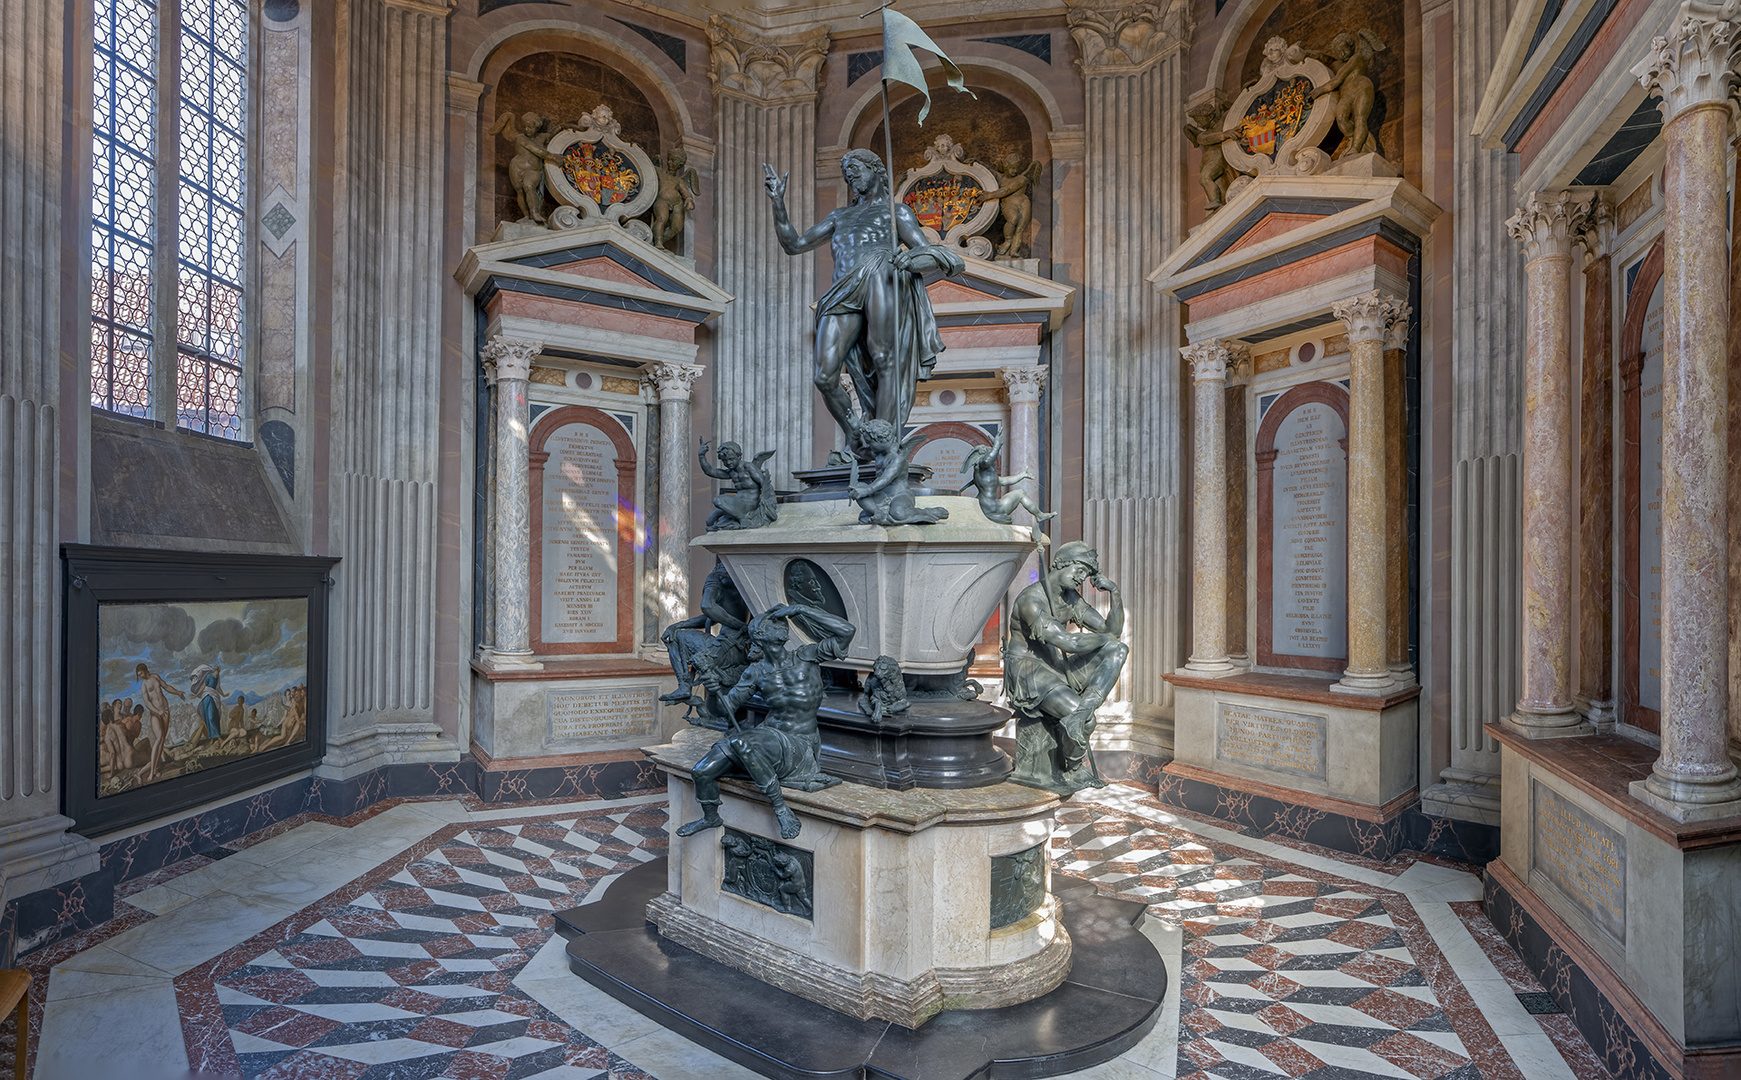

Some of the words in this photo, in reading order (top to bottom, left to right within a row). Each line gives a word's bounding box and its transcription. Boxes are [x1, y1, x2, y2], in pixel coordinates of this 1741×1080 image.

[570, 714, 628, 722] DISTINGUUNTUR
[1224, 710, 1251, 718] BEATAE
[1286, 720, 1317, 729] QUARUM
[1242, 721, 1280, 732] VIRTUTES
[1229, 726, 1255, 736] MUNDO
[1258, 732, 1286, 741] PARTUS
[1289, 738, 1312, 746] HUNC
[1274, 751, 1292, 759] POST
[1285, 745, 1311, 754] ATQUE
[1560, 809, 1580, 828] ALIUD
[1555, 831, 1571, 849] QUOD
[1574, 845, 1583, 859] DE
[1585, 855, 1620, 888] SUPREMIS
[1602, 852, 1618, 871] TORI
[1569, 869, 1577, 882] ET
